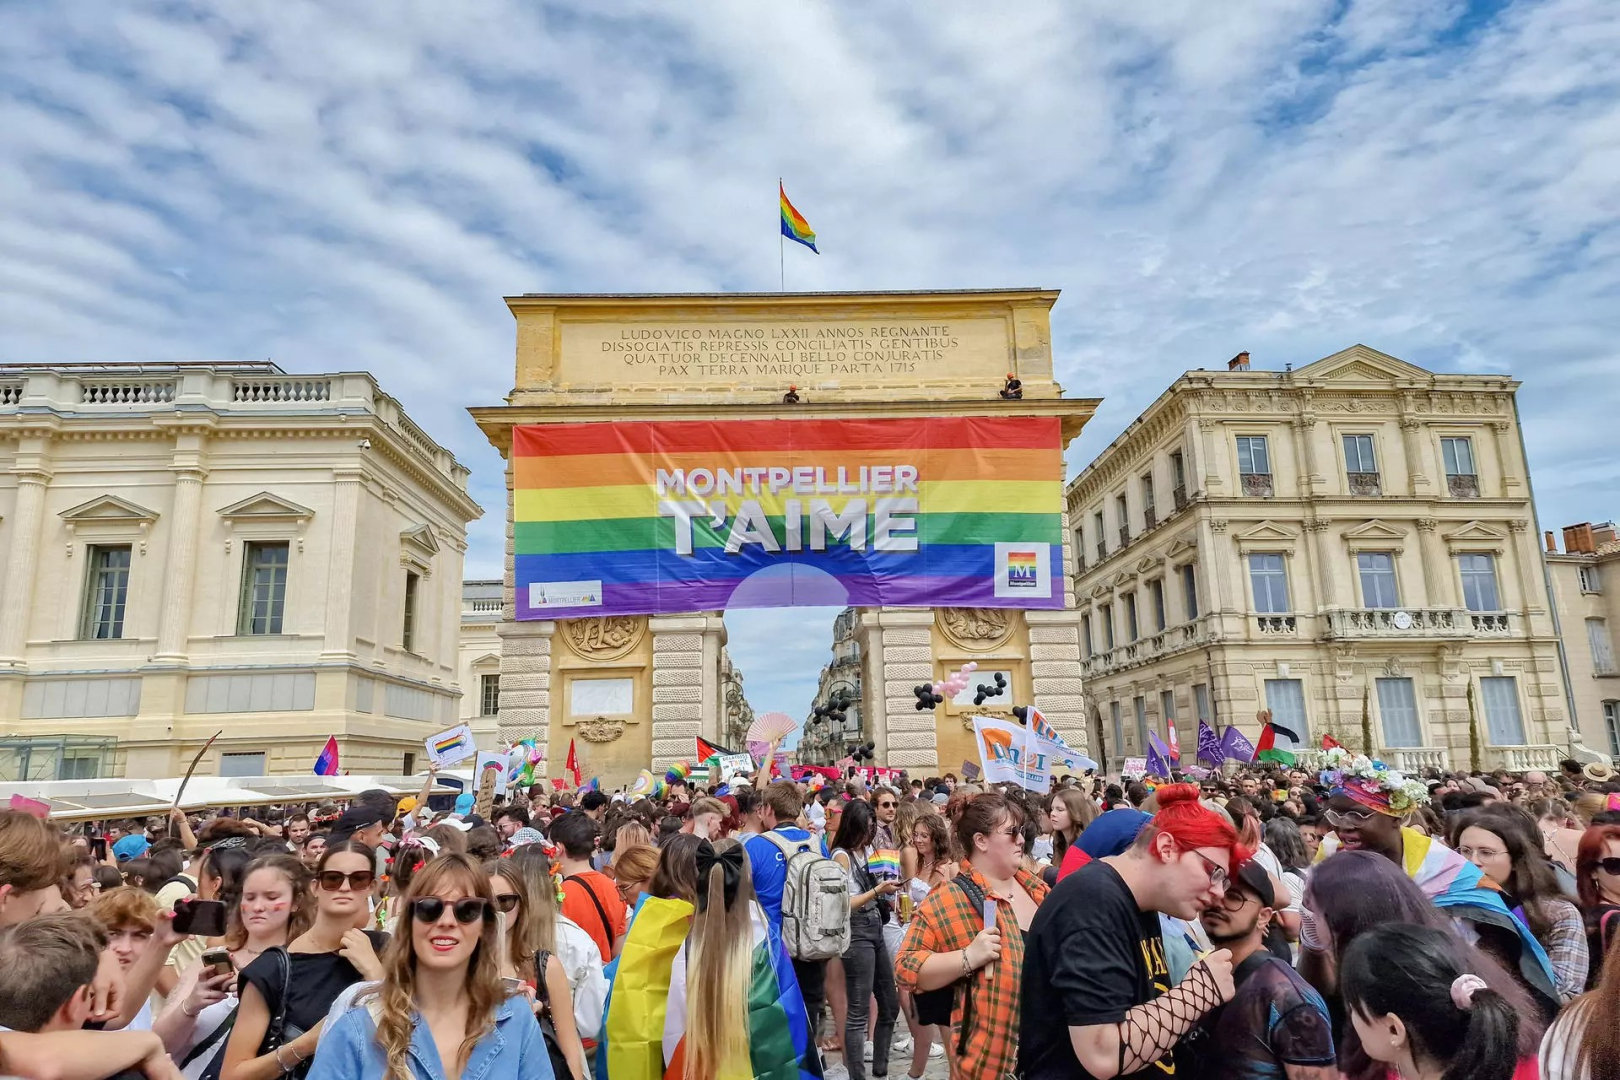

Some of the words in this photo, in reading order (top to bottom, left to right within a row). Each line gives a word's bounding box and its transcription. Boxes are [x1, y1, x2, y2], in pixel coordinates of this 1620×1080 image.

[621, 329, 702, 340] LUDOVICO
[708, 328, 764, 339] MAGNO
[771, 328, 809, 339] LXXII
[816, 327, 864, 338] ANNOS
[871, 326, 950, 337] REGNANTE
[601, 341, 694, 352] DISSOCIATIS
[700, 340, 769, 351] REPRESSIS
[776, 339, 872, 350] CONCILIATIS
[880, 337, 959, 349] GENTIBUS
[623, 353, 702, 365] QUATUOR
[709, 352, 794, 363] DECENNALI
[800, 351, 846, 362] BELLO
[853, 350, 943, 362] CONJURATIS
[659, 365, 689, 376] PAX
[697, 365, 748, 375] TERRA
[756, 364, 824, 377] MARIQUE
[830, 363, 883, 374] PARTA
[890, 362, 915, 373] 1715
[655, 464, 918, 496] MONTPELLIER
[657, 498, 919, 556] T'AIME
[1013, 564, 1032, 578] M
